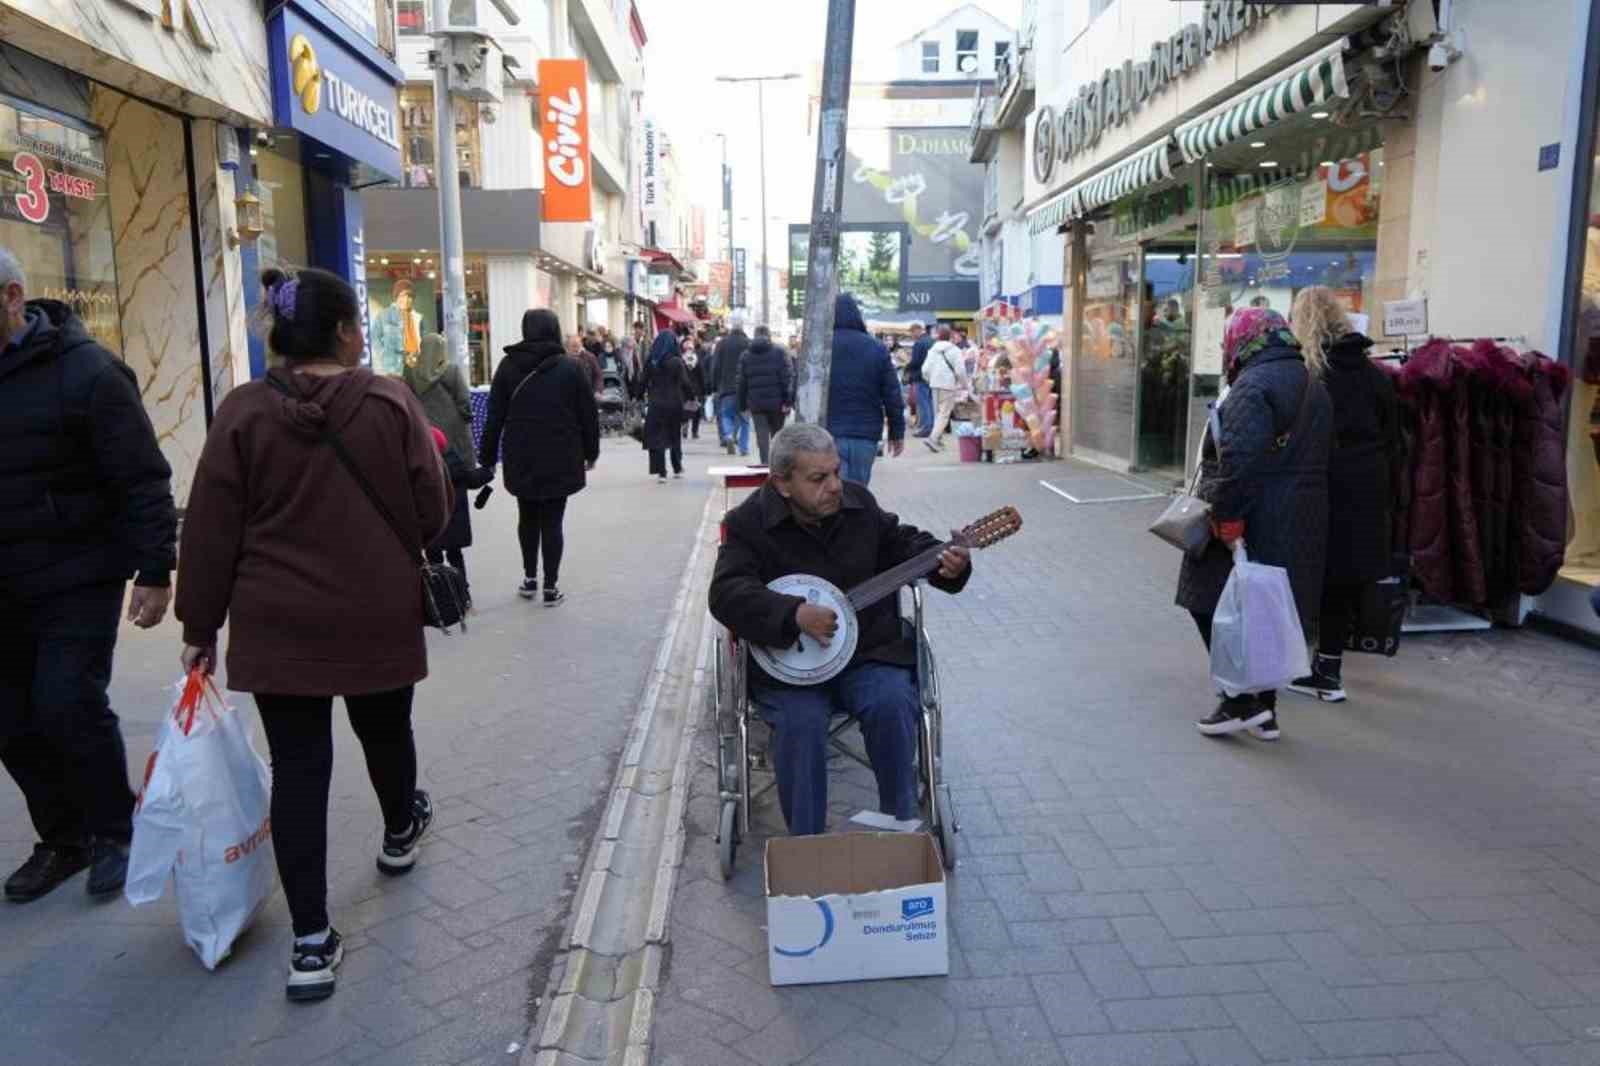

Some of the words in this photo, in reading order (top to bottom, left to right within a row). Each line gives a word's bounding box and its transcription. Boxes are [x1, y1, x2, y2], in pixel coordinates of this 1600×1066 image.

[14, 152, 50, 223] 3
[352, 228, 371, 366] URKCELL
[907, 291, 931, 304] ND
